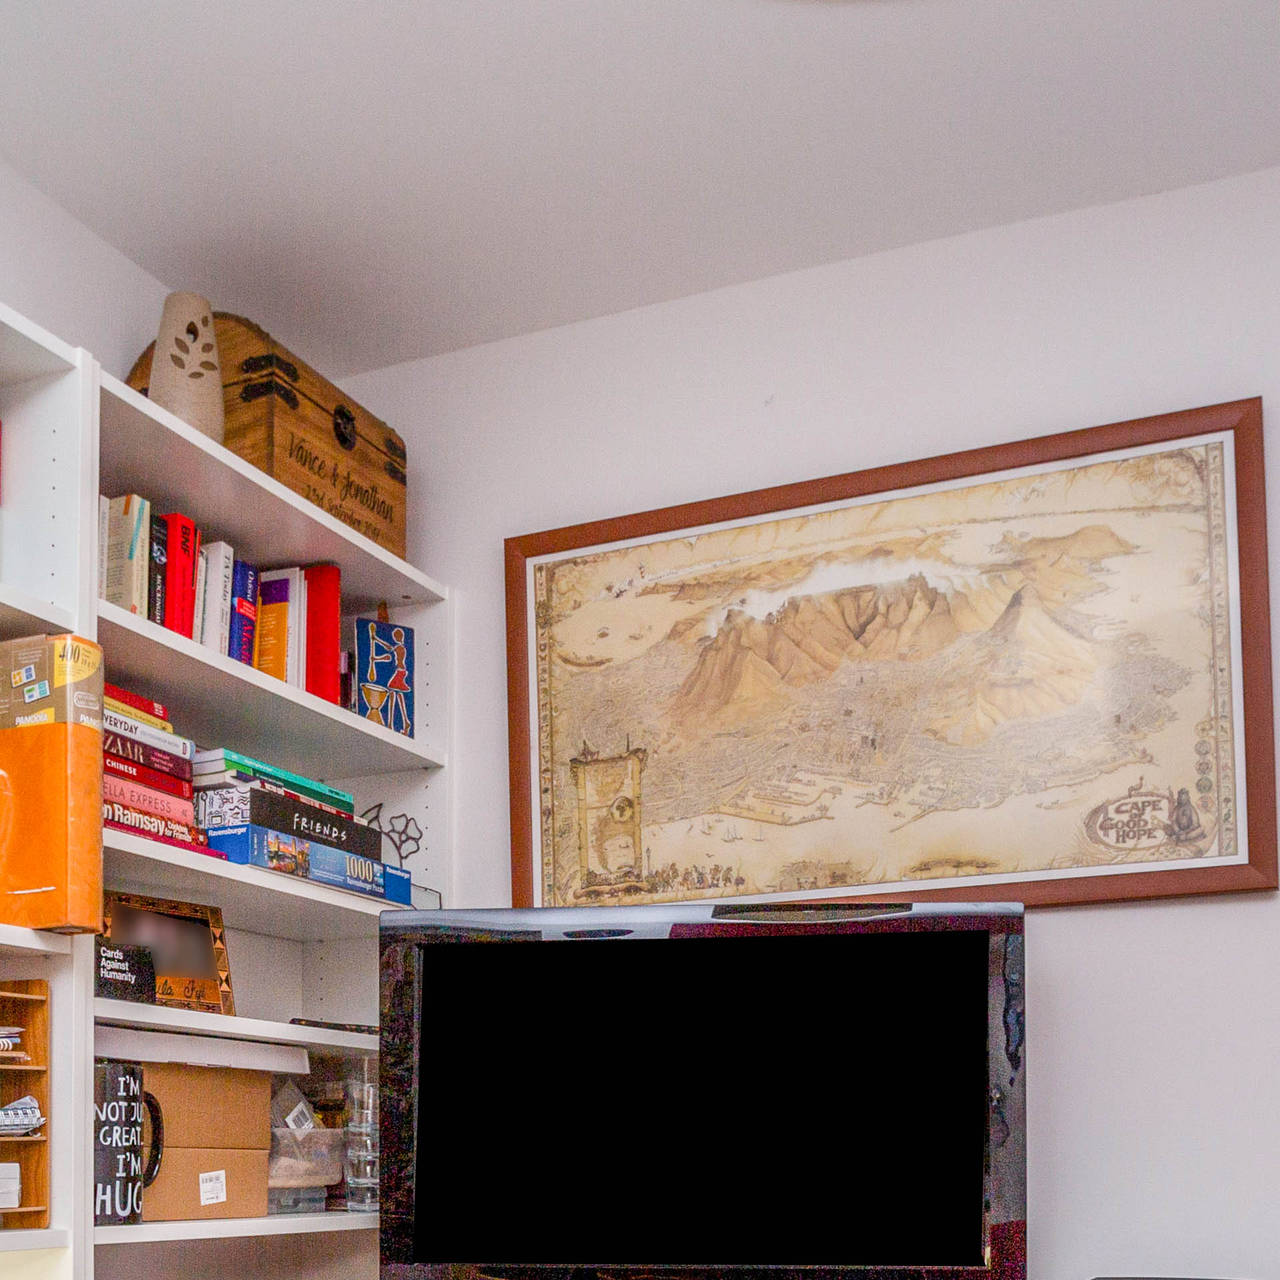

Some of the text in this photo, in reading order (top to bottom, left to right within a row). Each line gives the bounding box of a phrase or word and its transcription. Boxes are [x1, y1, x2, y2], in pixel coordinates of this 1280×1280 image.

[287, 431, 326, 480] Vance
[340, 470, 394, 524] Jonathan
[179, 524, 191, 558] BNF
[246, 570, 255, 602] Oxford
[105, 758, 137, 776] CHINESE
[129, 788, 172, 812] EXPRESS
[1113, 801, 1163, 814] CAPE
[112, 801, 167, 837] Ramsay
[293, 812, 347, 842] FRIENDS
[1098, 817, 1149, 834] GOOD
[208, 826, 248, 838] Ravensburger
[1115, 829, 1157, 844] HOPE
[345, 855, 373, 882] 1000
[100, 946, 124, 960] Cards
[100, 957, 129, 971] Against
[100, 967, 136, 984] Humanity
[117, 1075, 140, 1097] I'M
[94, 1101, 128, 1122] NOT
[115, 1152, 142, 1178] I'M
